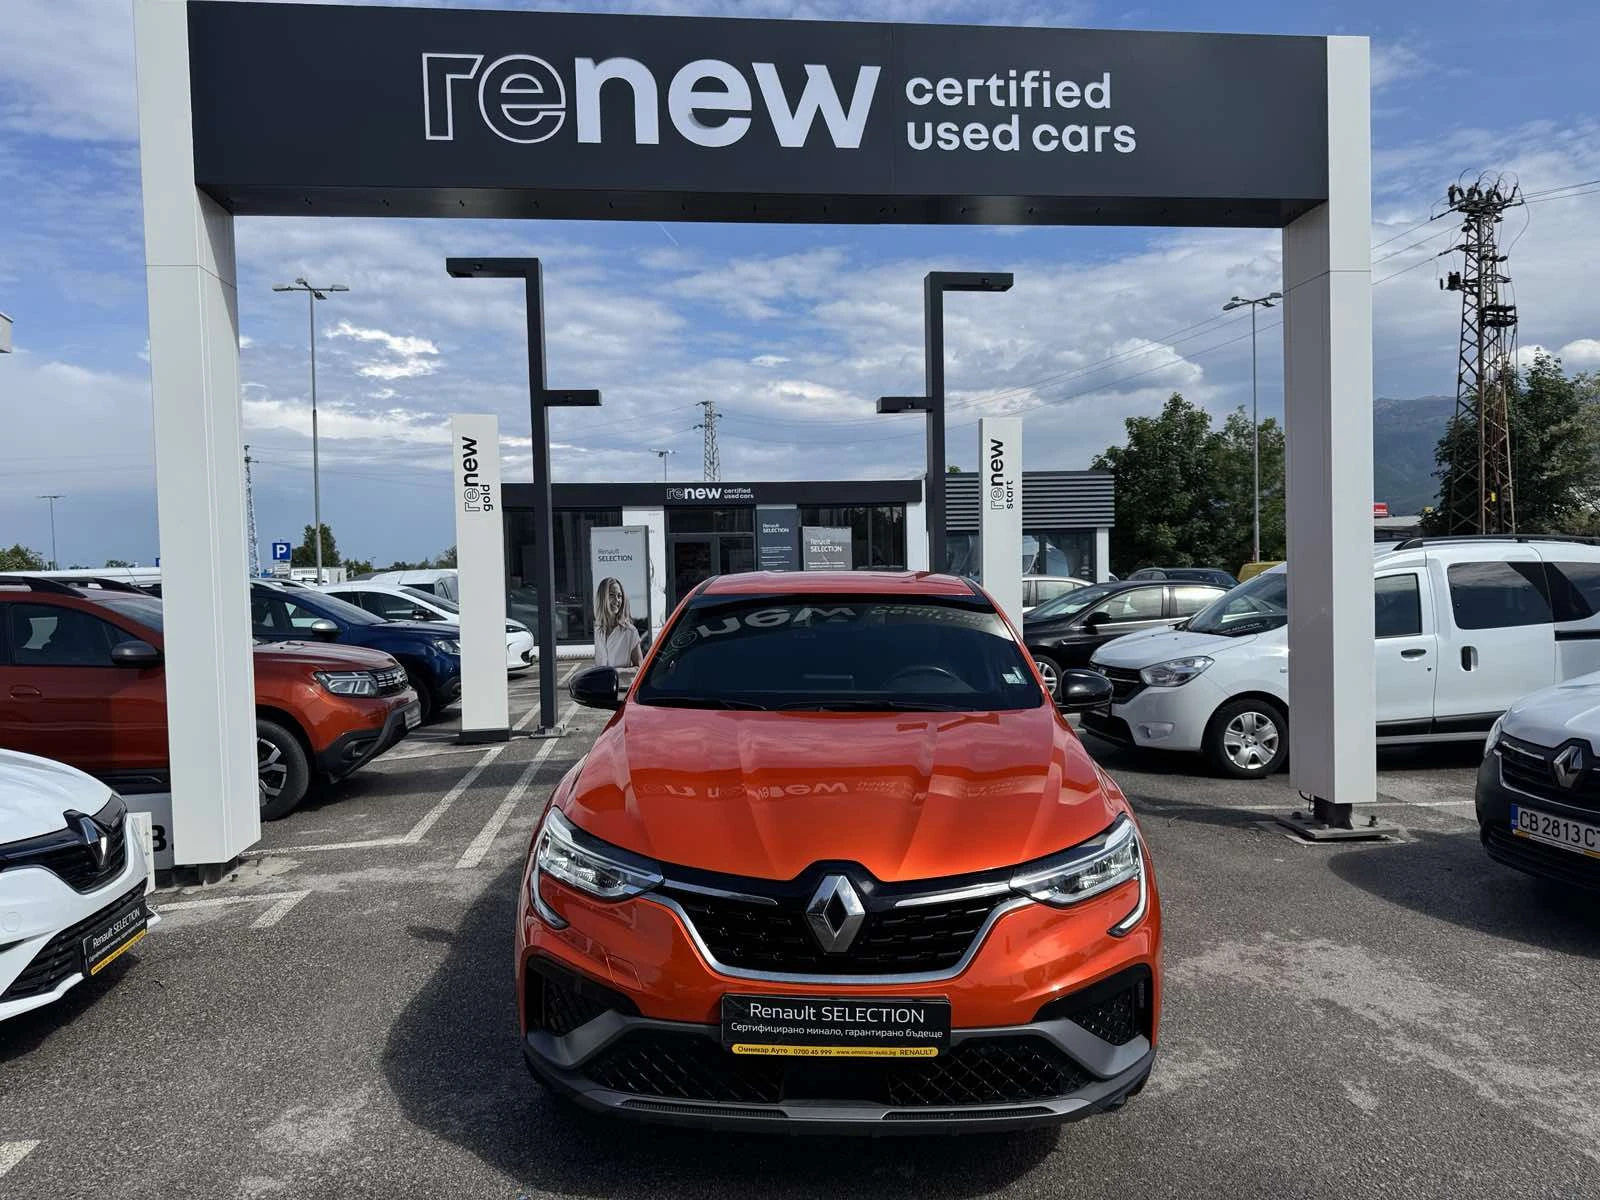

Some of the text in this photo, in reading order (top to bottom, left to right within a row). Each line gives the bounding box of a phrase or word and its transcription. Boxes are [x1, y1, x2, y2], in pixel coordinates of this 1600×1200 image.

[421, 52, 881, 149] renew
[905, 69, 1111, 109] certified
[907, 114, 1137, 153] used cars
[462, 436, 481, 512] renew
[990, 438, 1004, 510] renew
[480, 484, 494, 512] gold
[666, 487, 722, 500] renew
[1006, 480, 1014, 509] start
[276, 544, 287, 559] P
[1542, 817, 1580, 843] 2813
[750, 1003, 925, 1024] Renault SELECTION
[731, 1022, 943, 1039] Сертифицирано минало, гарантирано бъдеще
